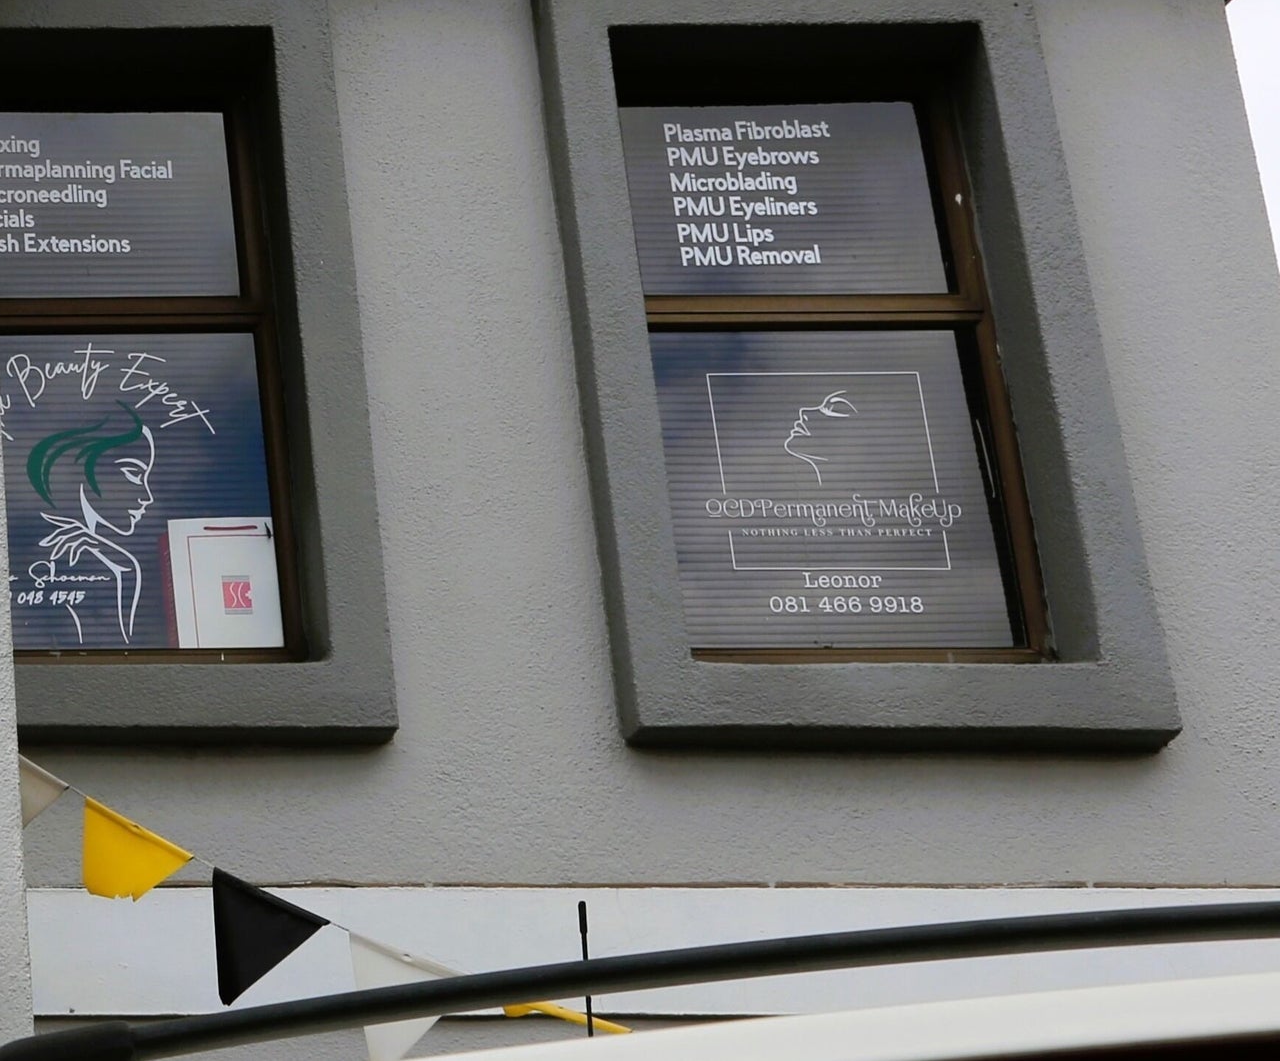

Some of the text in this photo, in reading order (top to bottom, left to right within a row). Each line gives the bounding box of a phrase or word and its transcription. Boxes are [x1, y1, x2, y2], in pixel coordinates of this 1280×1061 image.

[663, 120, 831, 143] Plasma Fibroblast
[119, 159, 173, 179] Facial
[667, 146, 820, 170] PMU Eyebrows
[669, 171, 798, 195] Microblading
[673, 196, 818, 220] PMU Eyeliners
[24, 233, 131, 253] Extensions
[677, 223, 775, 245] PMU Lips
[680, 244, 822, 267] PMU Removal
[6, 343, 215, 435] Beauty Expert
[741, 528, 932, 537] NOTHING LESS THAN PERFECT
[28, 560, 111, 588] Schoeman
[802, 572, 882, 589] Leonor
[769, 596, 924, 614] 081 466 9918
